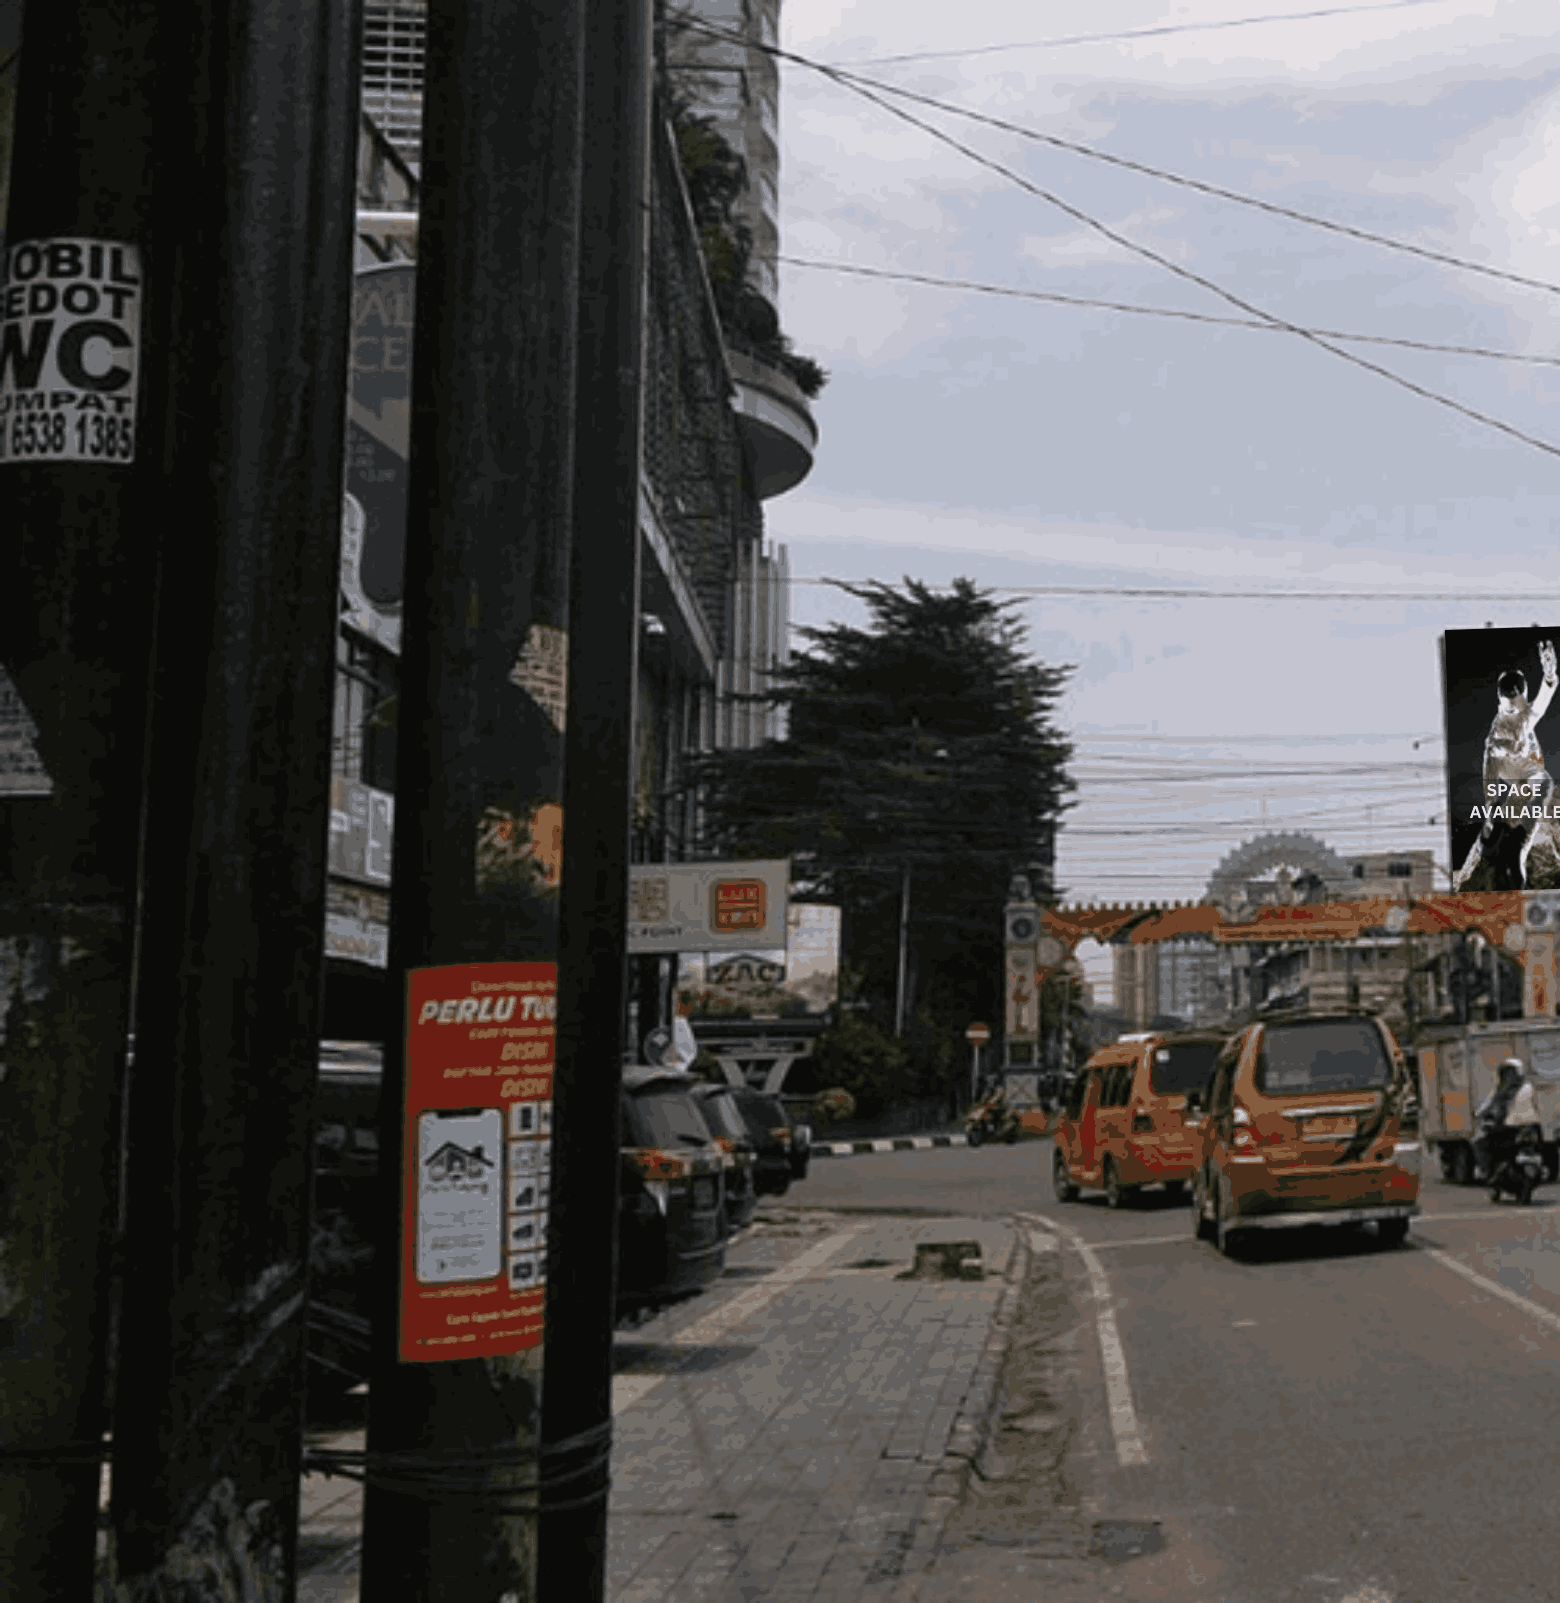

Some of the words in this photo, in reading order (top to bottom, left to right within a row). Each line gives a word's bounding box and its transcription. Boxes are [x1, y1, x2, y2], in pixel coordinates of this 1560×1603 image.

[5, 244, 139, 286] OBIL
[0, 282, 136, 320] EDOT
[1486, 783, 1542, 797] SPACE
[417, 994, 517, 1025] PERLU
